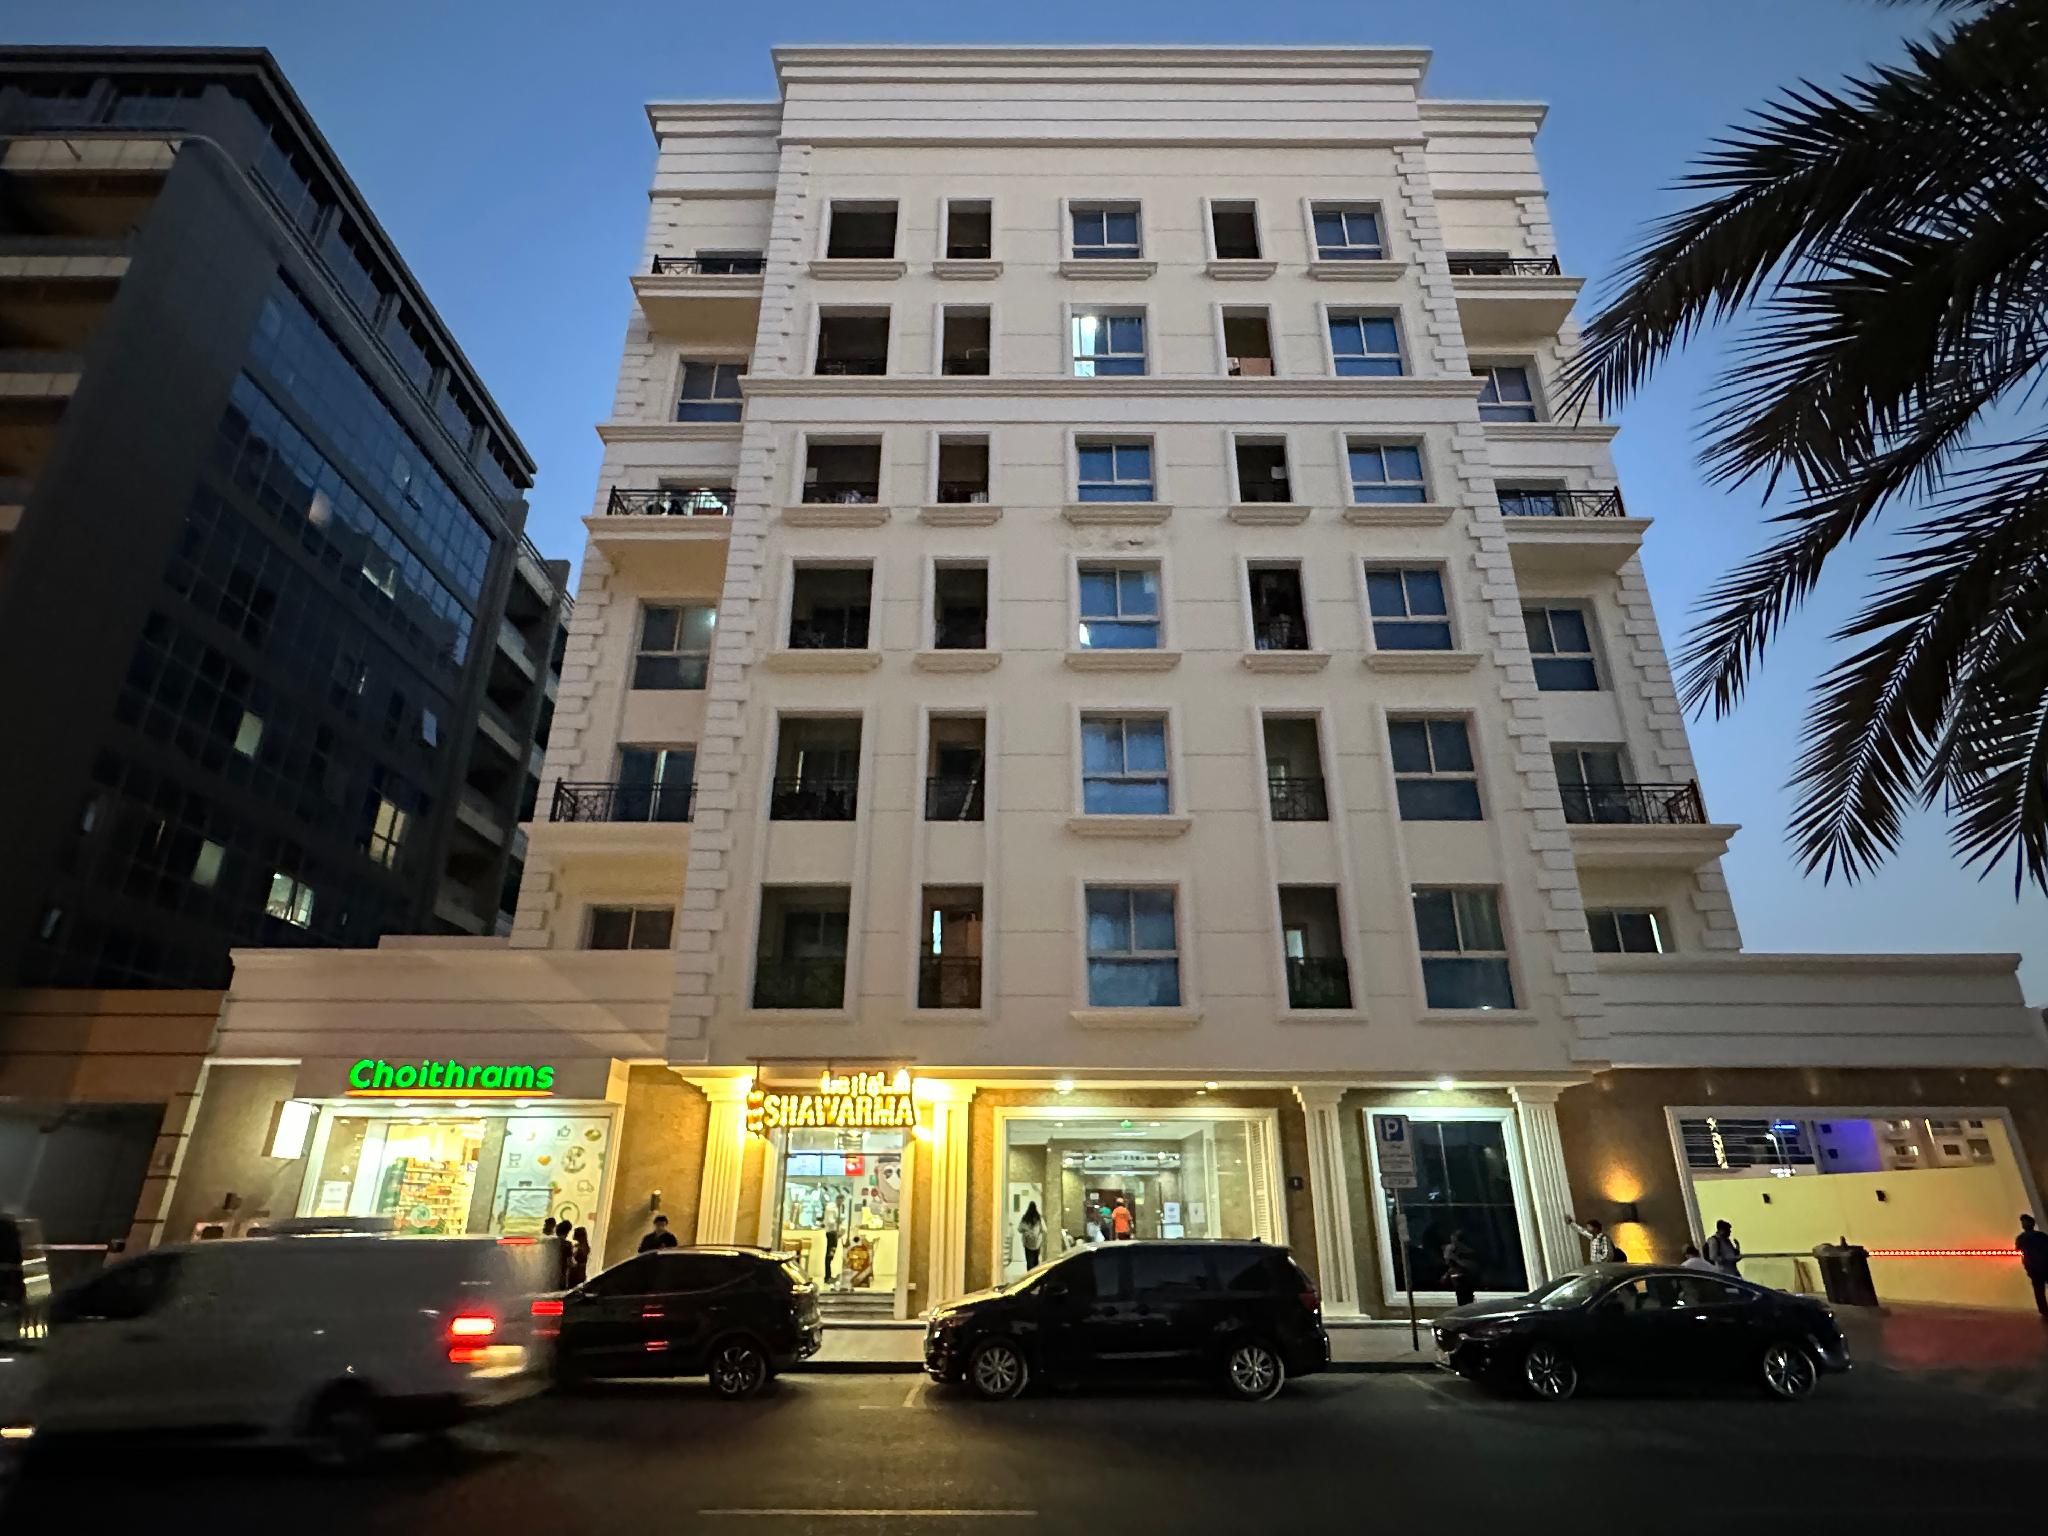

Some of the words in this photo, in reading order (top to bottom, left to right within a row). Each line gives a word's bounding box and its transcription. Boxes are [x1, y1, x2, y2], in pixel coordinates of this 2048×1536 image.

[349, 1059, 555, 1089] Choithrams
[763, 1094, 914, 1127] SHAWARMA
[1384, 1118, 1399, 1140] P
